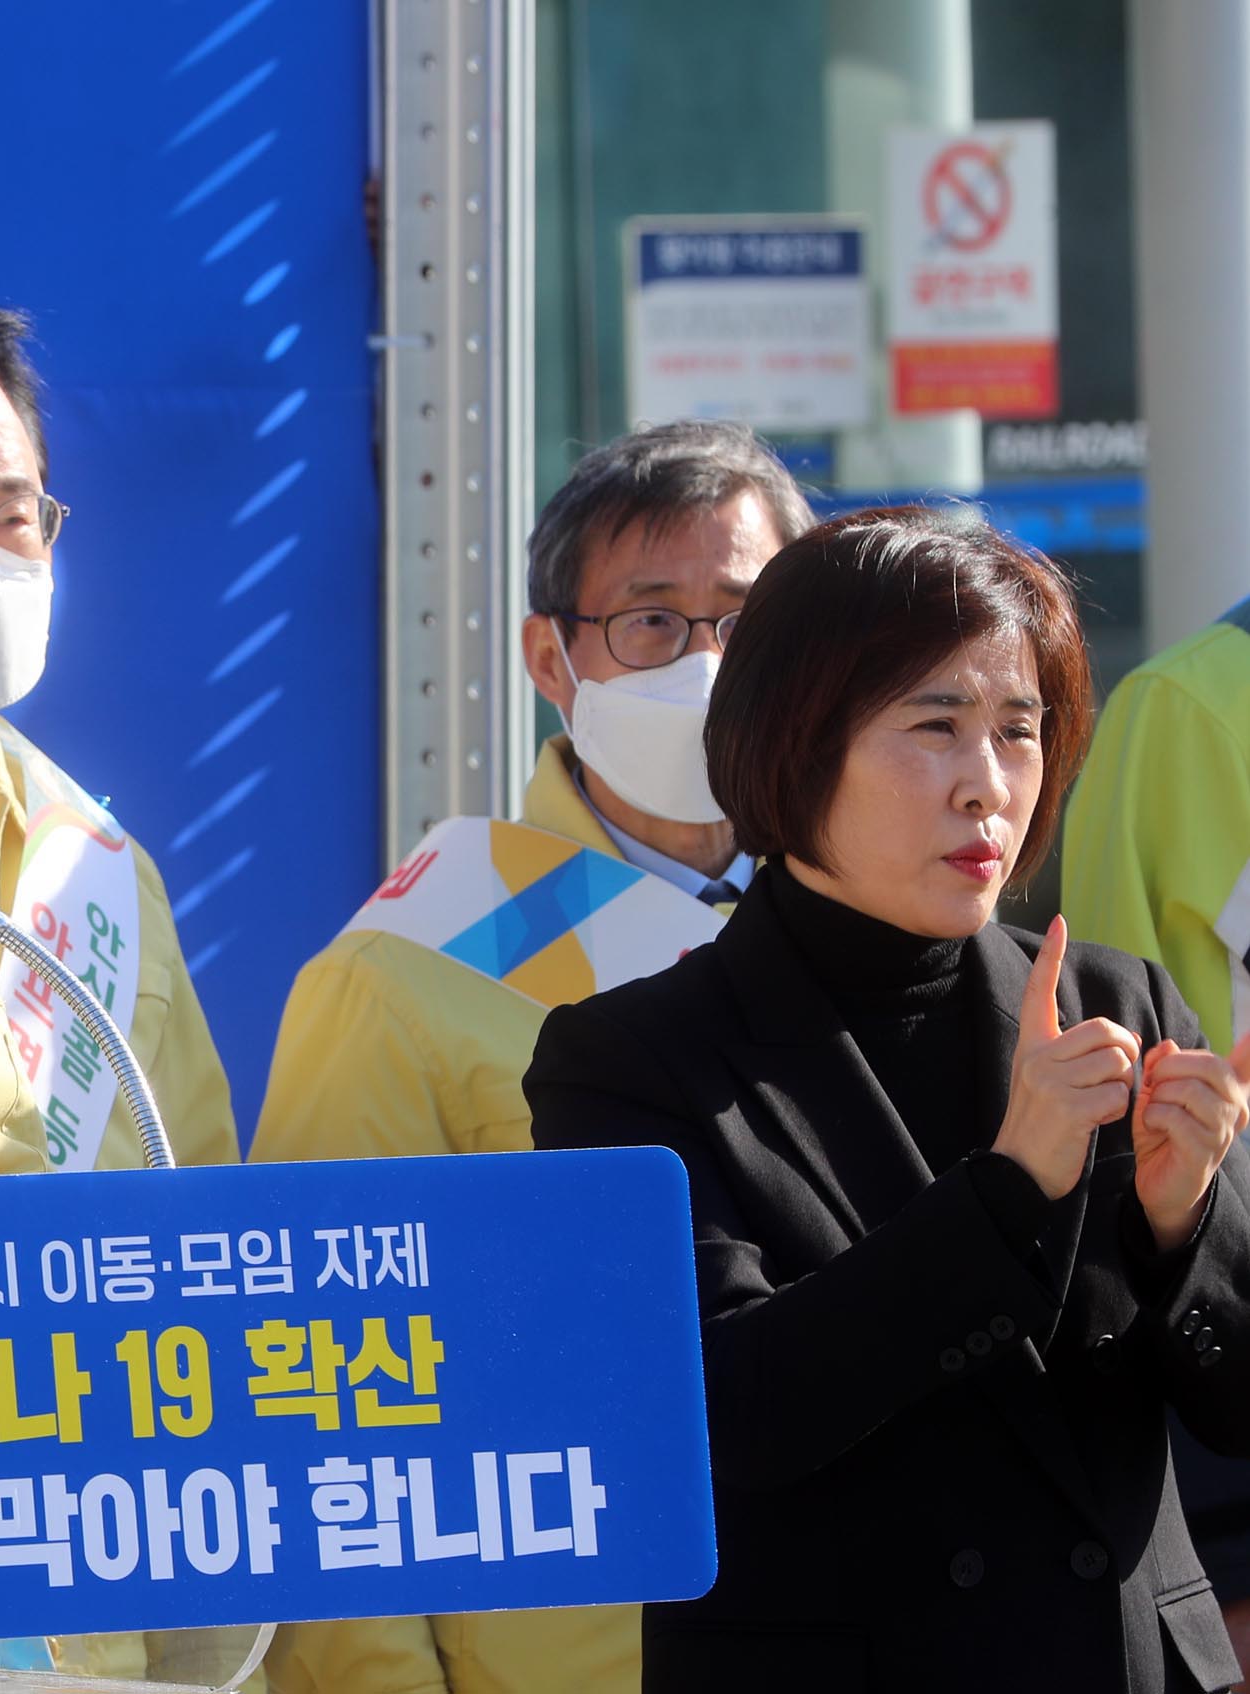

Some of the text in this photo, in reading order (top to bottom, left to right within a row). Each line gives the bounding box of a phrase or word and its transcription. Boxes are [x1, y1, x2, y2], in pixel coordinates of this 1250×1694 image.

[41, 1228, 295, 1304] 이동·모임
[313, 1222, 430, 1290] 자제
[115, 1325, 213, 1438] 19
[244, 1314, 445, 1431] 확산
[307, 1446, 607, 1571] 합니다
